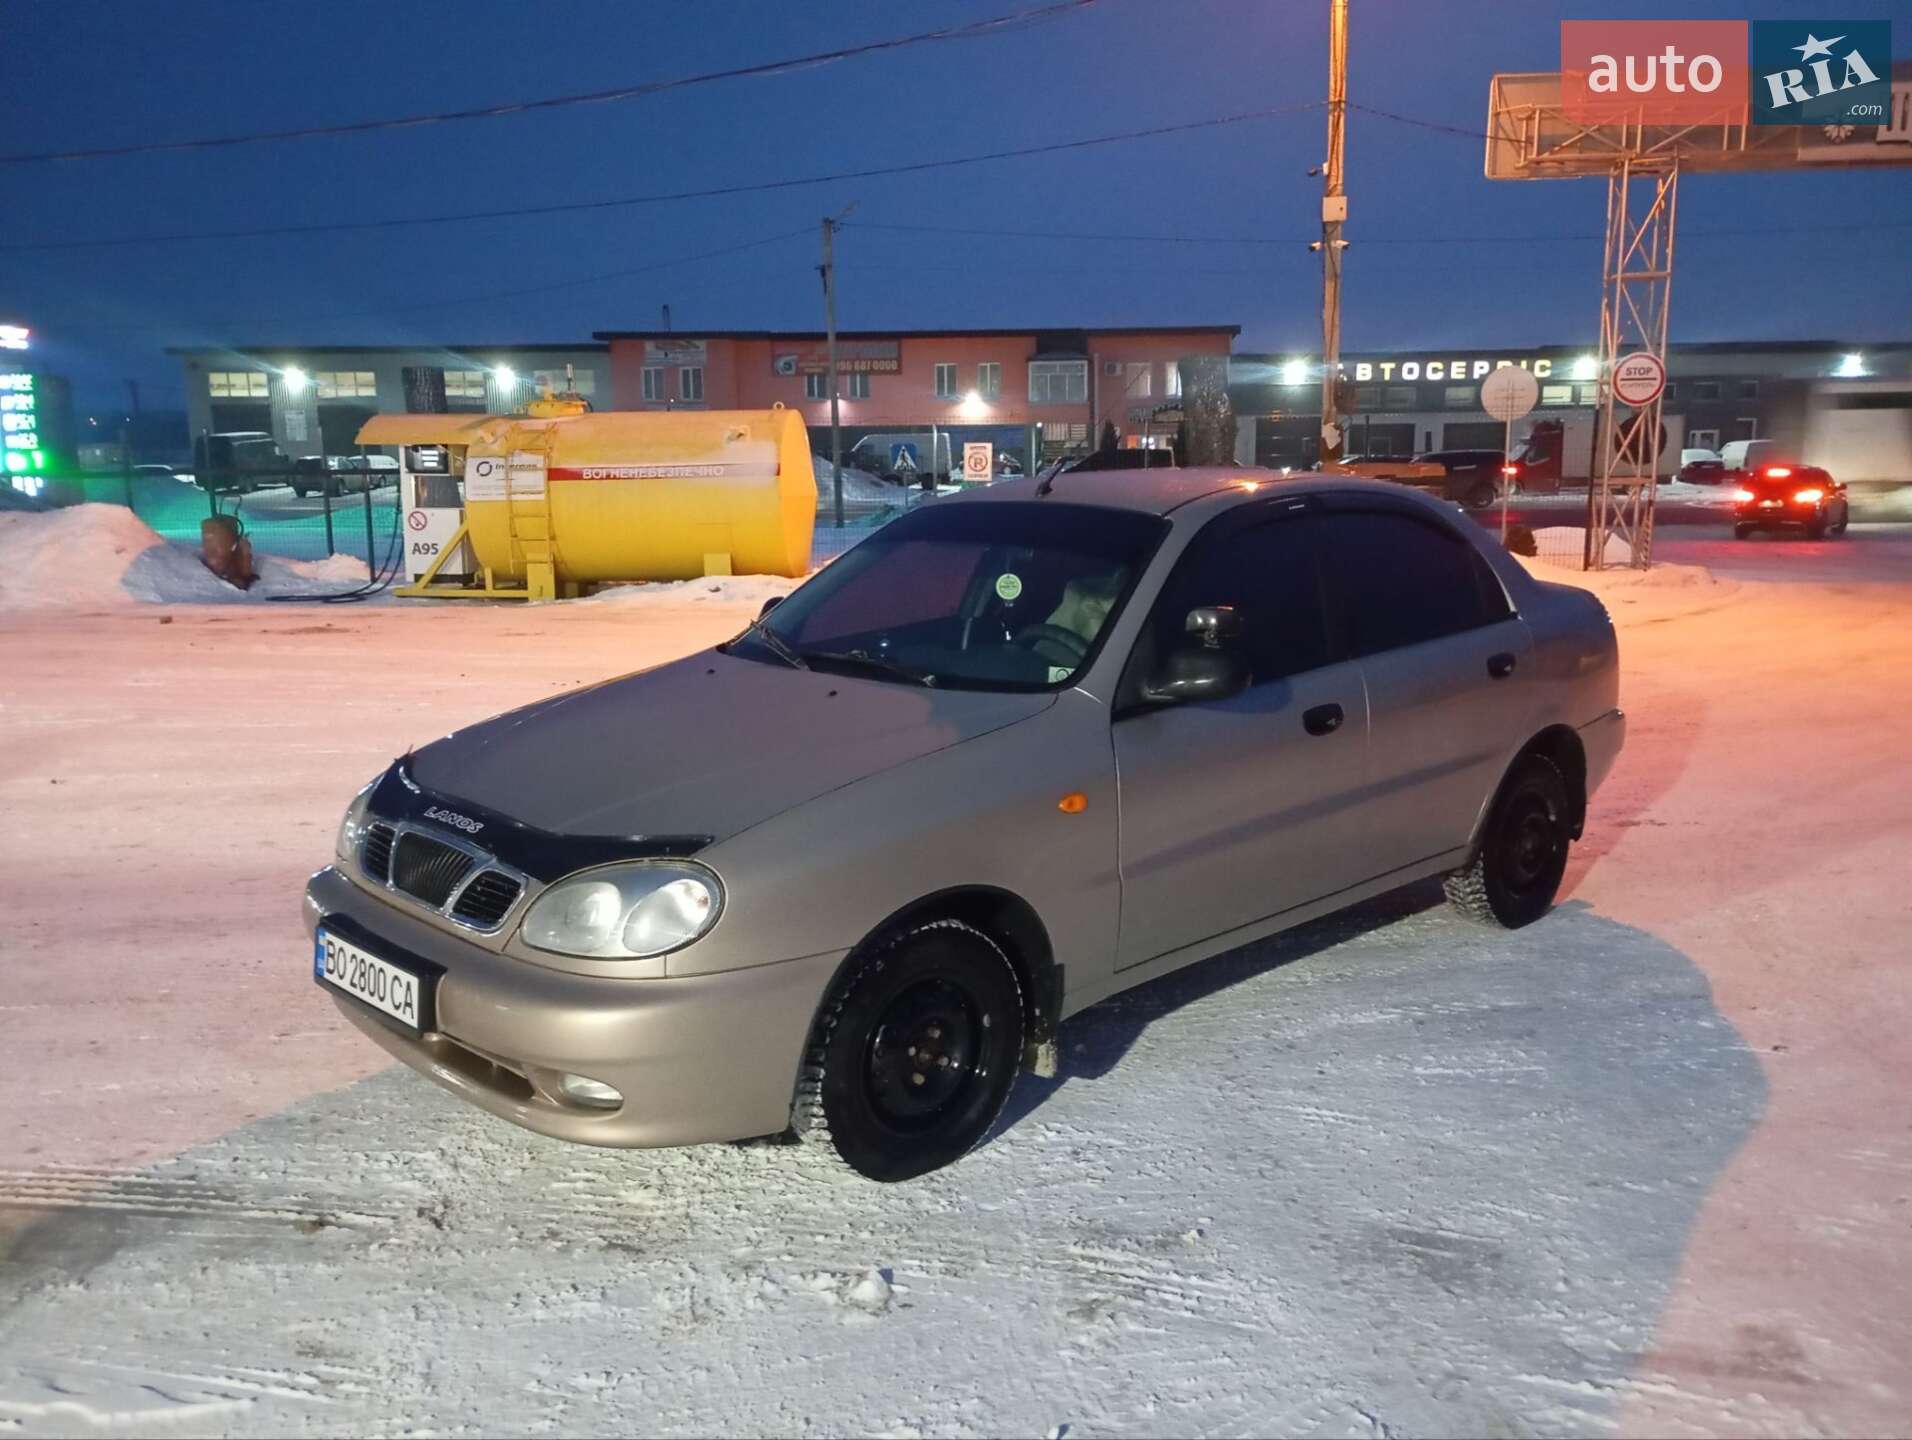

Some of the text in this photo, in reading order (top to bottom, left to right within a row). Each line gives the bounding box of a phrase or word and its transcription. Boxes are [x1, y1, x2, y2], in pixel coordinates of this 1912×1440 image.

[1625, 366, 1653, 376] STOP
[582, 465, 725, 480] ВОГНЕНЕБЕЗПЕЧНО
[423, 806, 485, 833] LANOS
[326, 940, 415, 1020] BO 2800 CA
